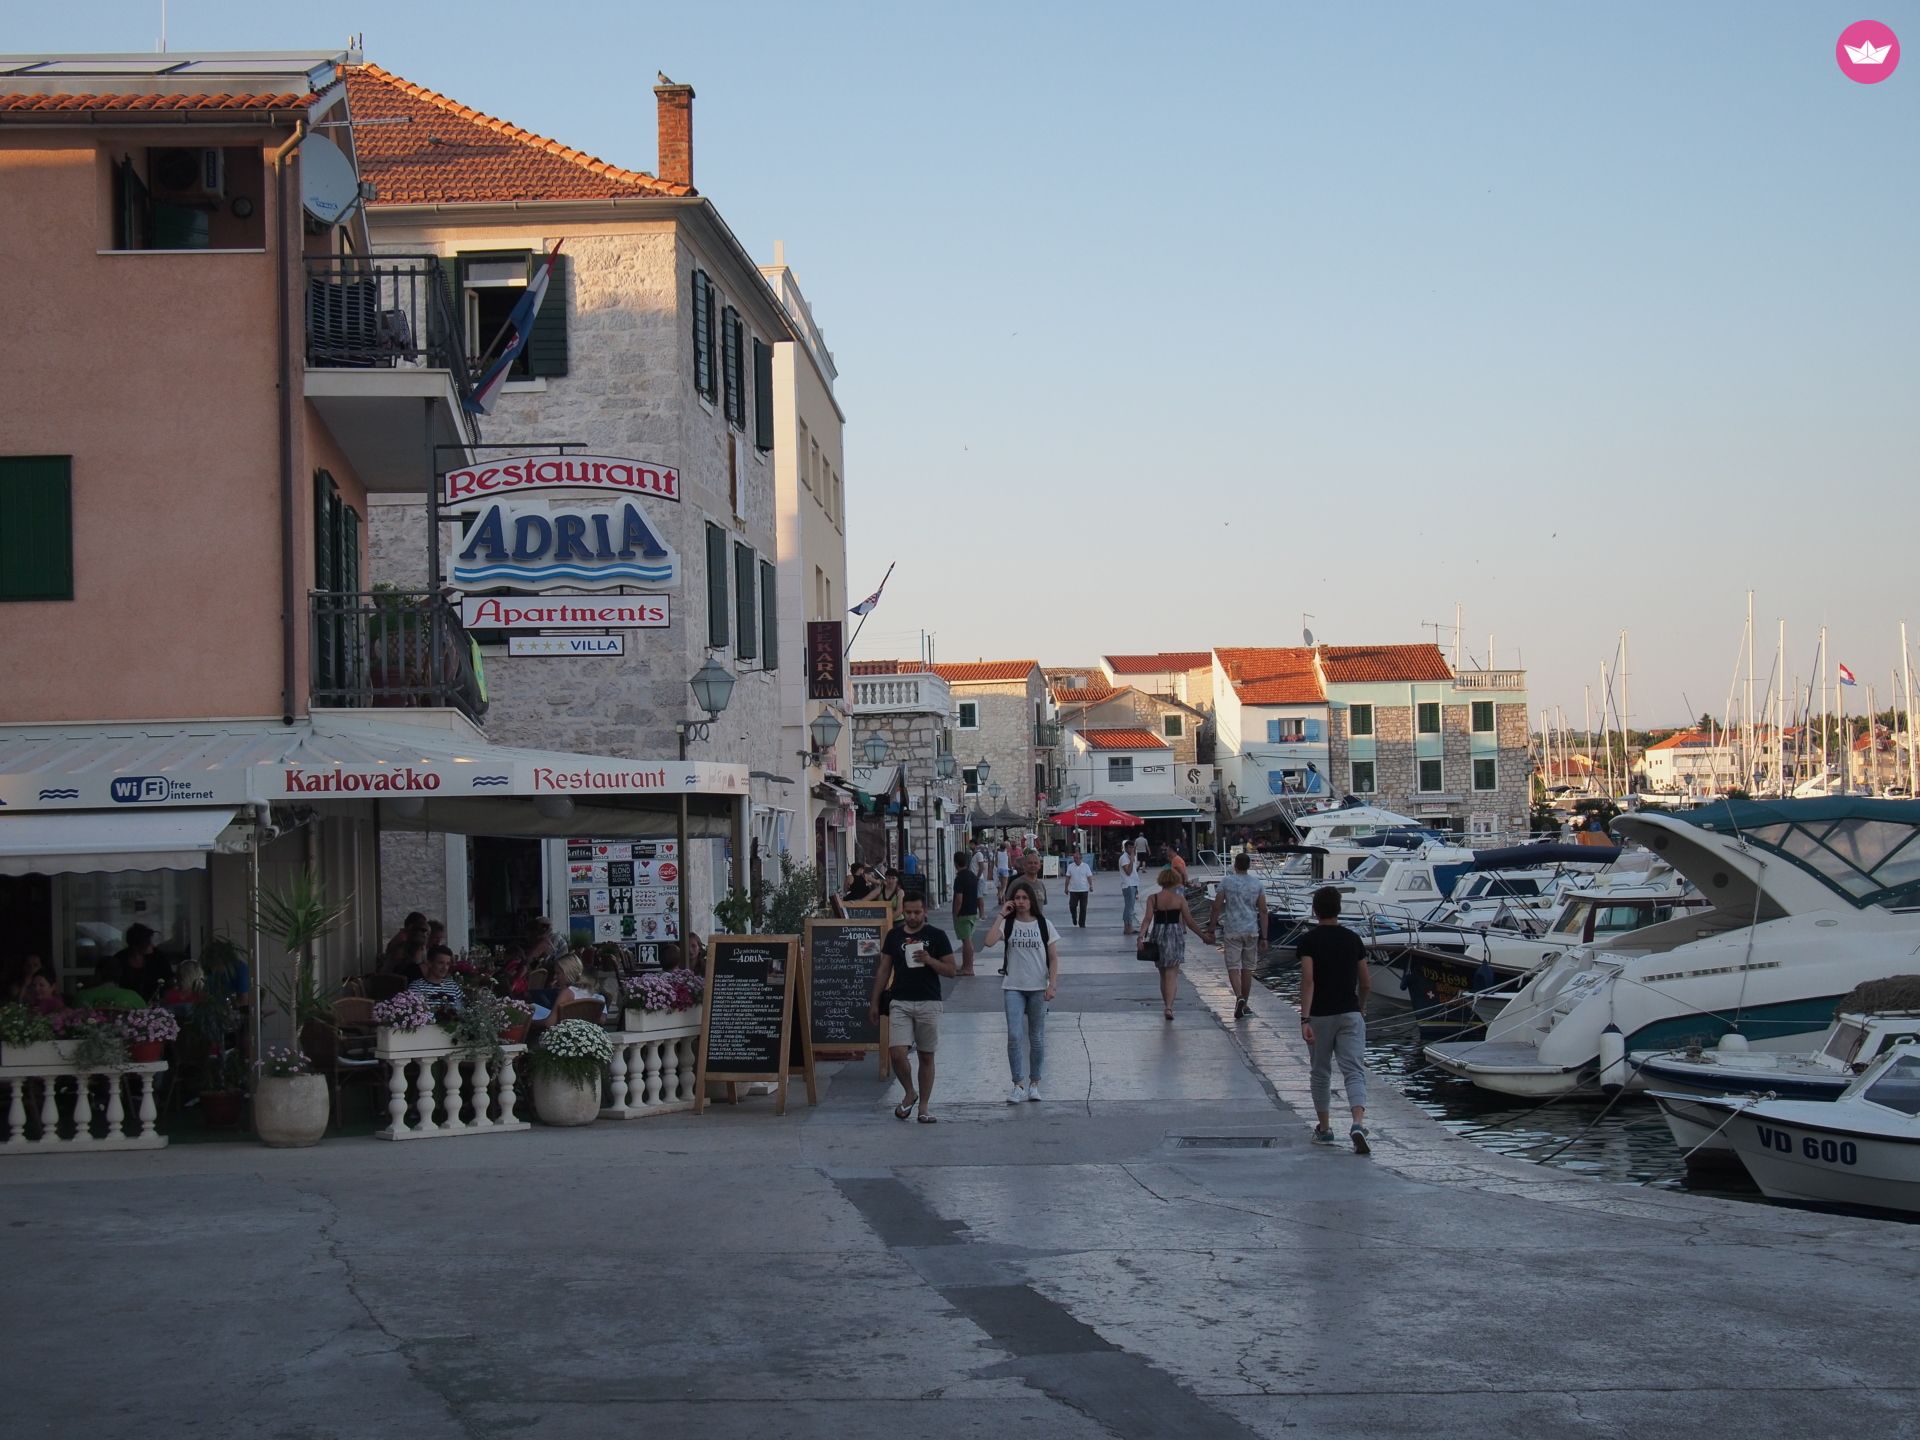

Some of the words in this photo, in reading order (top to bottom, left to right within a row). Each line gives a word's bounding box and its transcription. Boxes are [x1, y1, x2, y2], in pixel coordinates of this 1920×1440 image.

[448, 458, 678, 499] Restaurant
[458, 504, 669, 560] ADRIA
[468, 599, 665, 627] Apartments
[570, 641, 619, 651] VILLA
[815, 623, 834, 681] PEKARA
[170, 780, 192, 790] free
[285, 768, 441, 793] Karlovačko
[533, 767, 667, 791] Restaurant
[170, 789, 214, 800] internet
[846, 932, 872, 940] ADRIA
[1014, 929, 1039, 938] Hello
[1012, 938, 1042, 950] Friday
[736, 953, 765, 963] ADRIA
[1757, 1125, 1793, 1153] VD
[1802, 1137, 1858, 1165] 600
